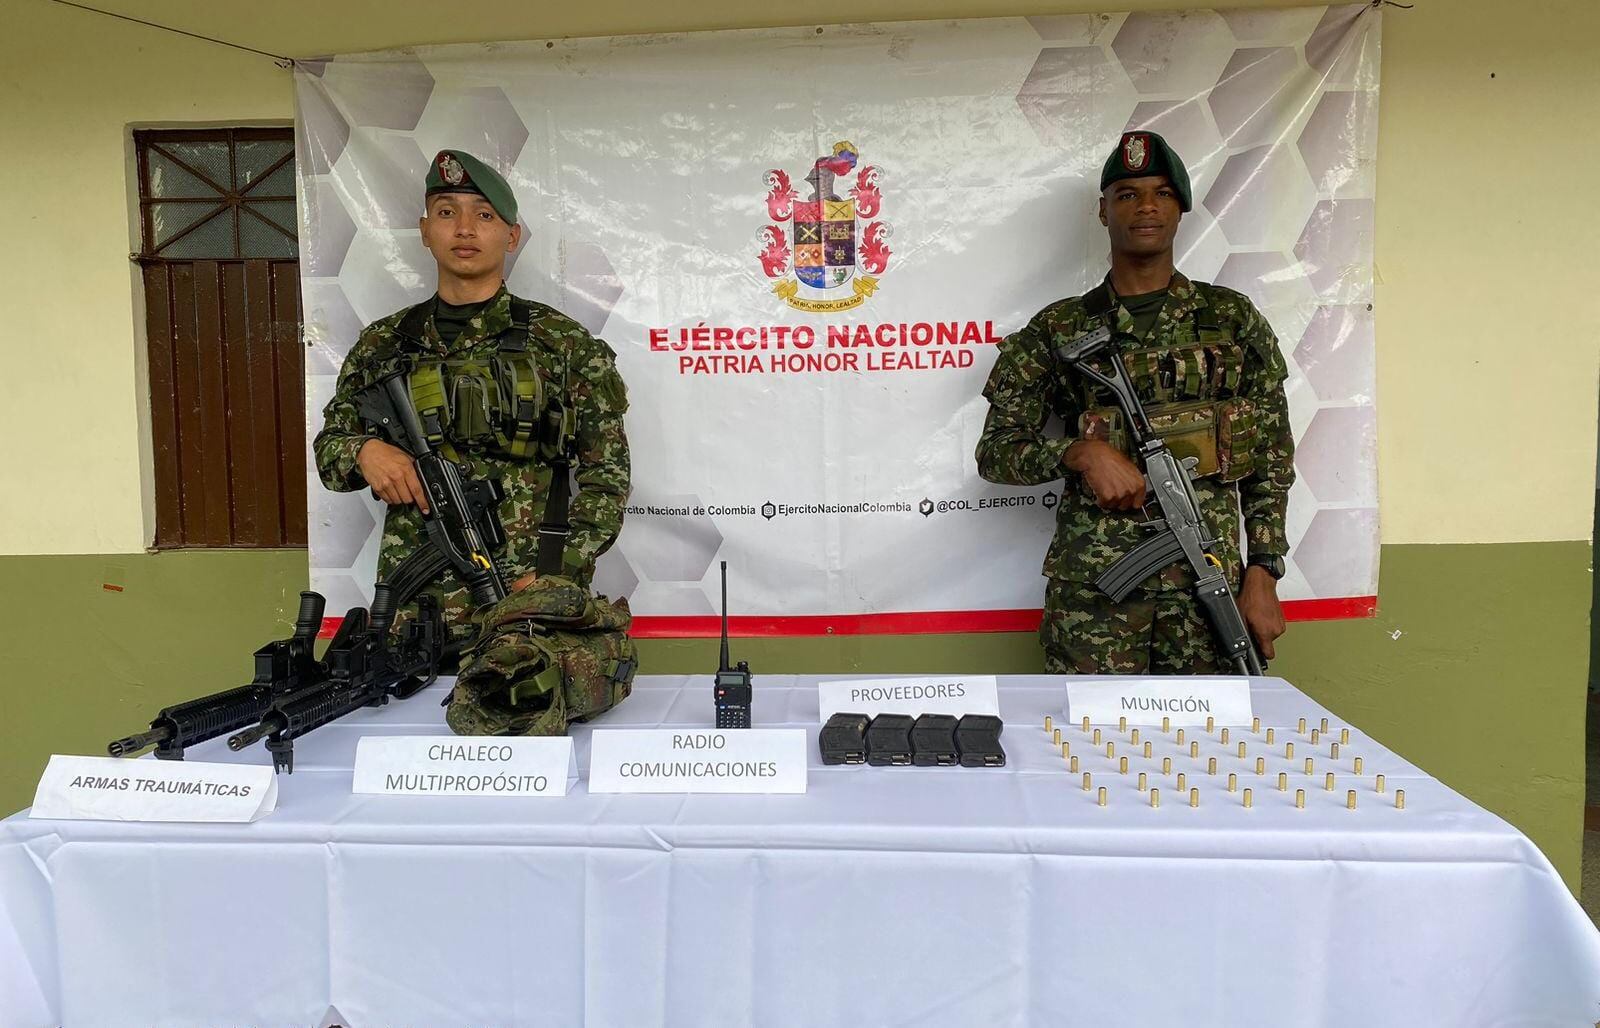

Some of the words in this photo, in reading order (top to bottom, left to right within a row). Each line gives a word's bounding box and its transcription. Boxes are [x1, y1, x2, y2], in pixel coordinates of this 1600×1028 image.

[836, 297, 862, 309] LEALTAD
[649, 322, 815, 352] EJÉRCITO
[827, 320, 1003, 350] NACIONAL
[679, 355, 764, 374] PATRIA
[771, 352, 860, 373] HONOR
[866, 350, 974, 371] LEALTAD
[623, 505, 645, 515] rcito
[647, 505, 690, 516] Nacional
[693, 505, 705, 516] de
[707, 505, 756, 516] Colombia
[778, 502, 912, 516] EjercitoNacionalColombia
[936, 495, 1036, 513] @COL_EJERCITO
[850, 683, 966, 702] PROVEEDORES
[1121, 695, 1211, 713] MUNICIÓN
[672, 734, 726, 750] RADIO
[428, 744, 513, 762] CHALECO
[619, 761, 777, 778] COMUNICACIONES
[69, 775, 131, 791] ARMAS
[134, 778, 252, 797] TRAUMÁTICAS
[385, 770, 548, 792] MULTIPROPÓSITO
